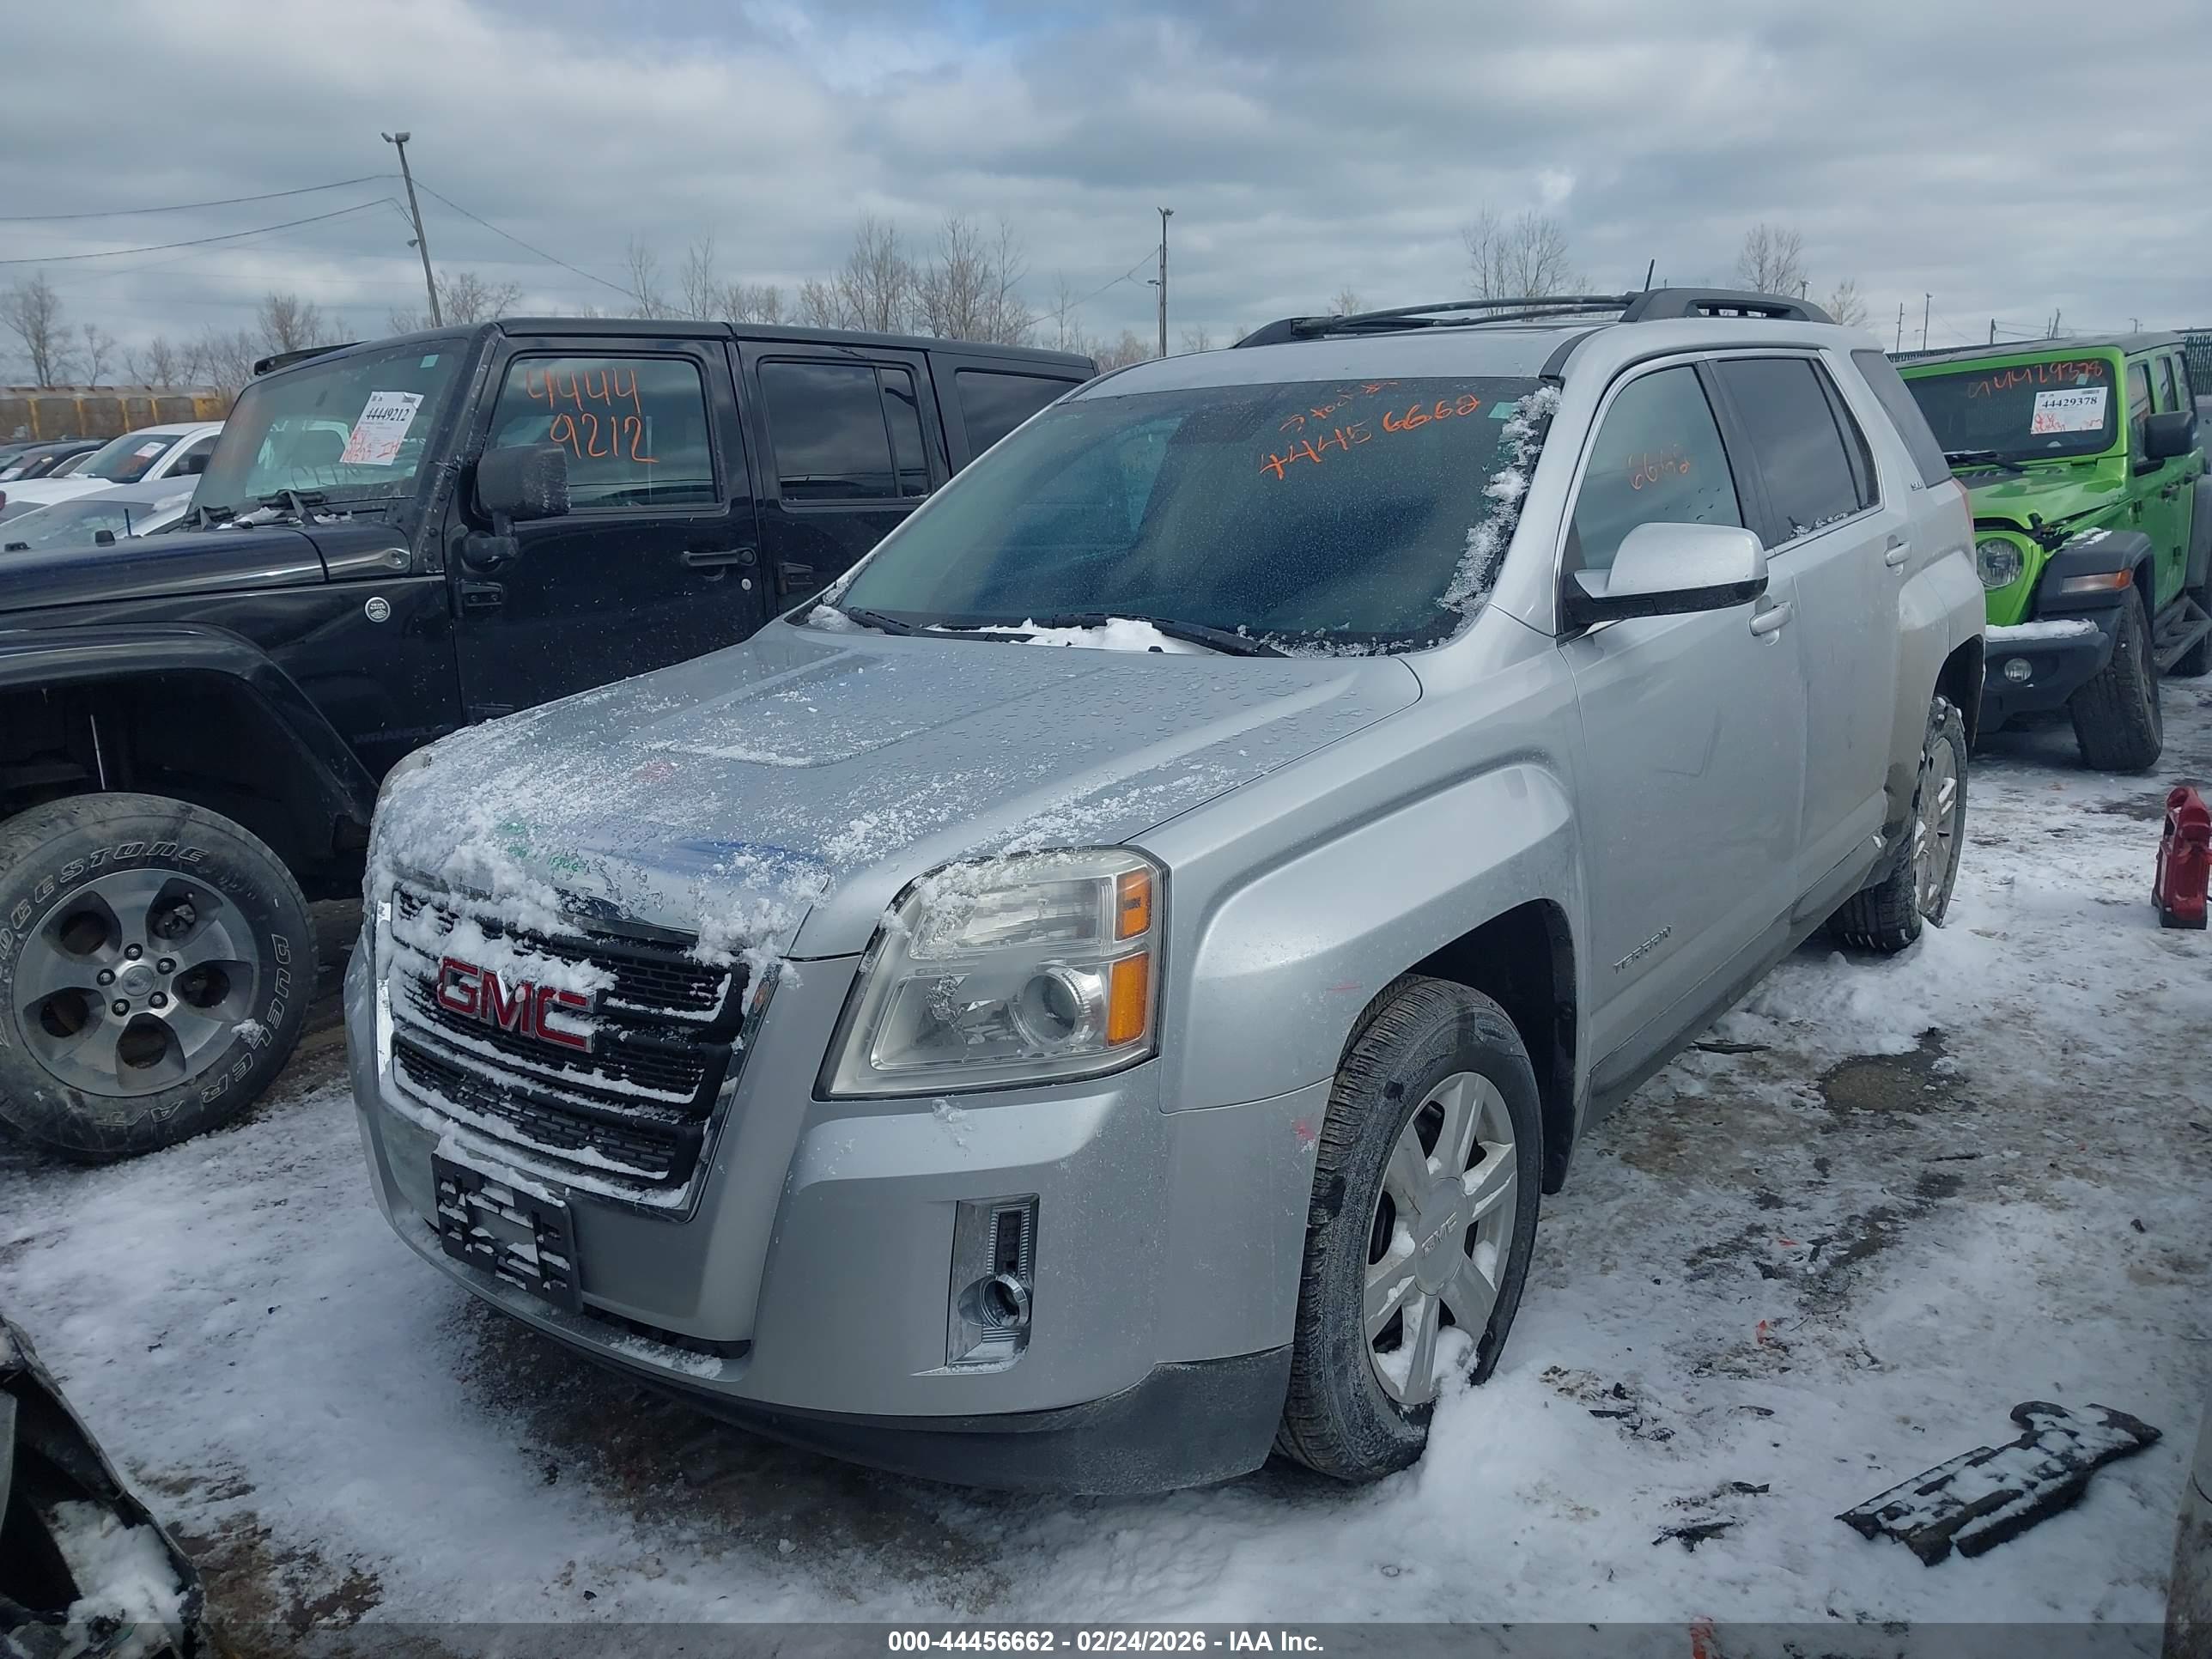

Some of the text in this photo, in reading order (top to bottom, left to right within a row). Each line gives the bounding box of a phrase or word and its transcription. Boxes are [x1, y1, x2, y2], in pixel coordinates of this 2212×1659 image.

[365, 407, 410, 422] 44449212
[526, 367, 641, 416] 4444
[2042, 396, 2098, 409] 44429378
[550, 412, 659, 463] 9212
[0, 841, 209, 960] DGESTONE
[201, 933, 291, 1103] DUELER
[437, 956, 597, 1054] GMC
[1422, 1212, 1457, 1258] GMC
